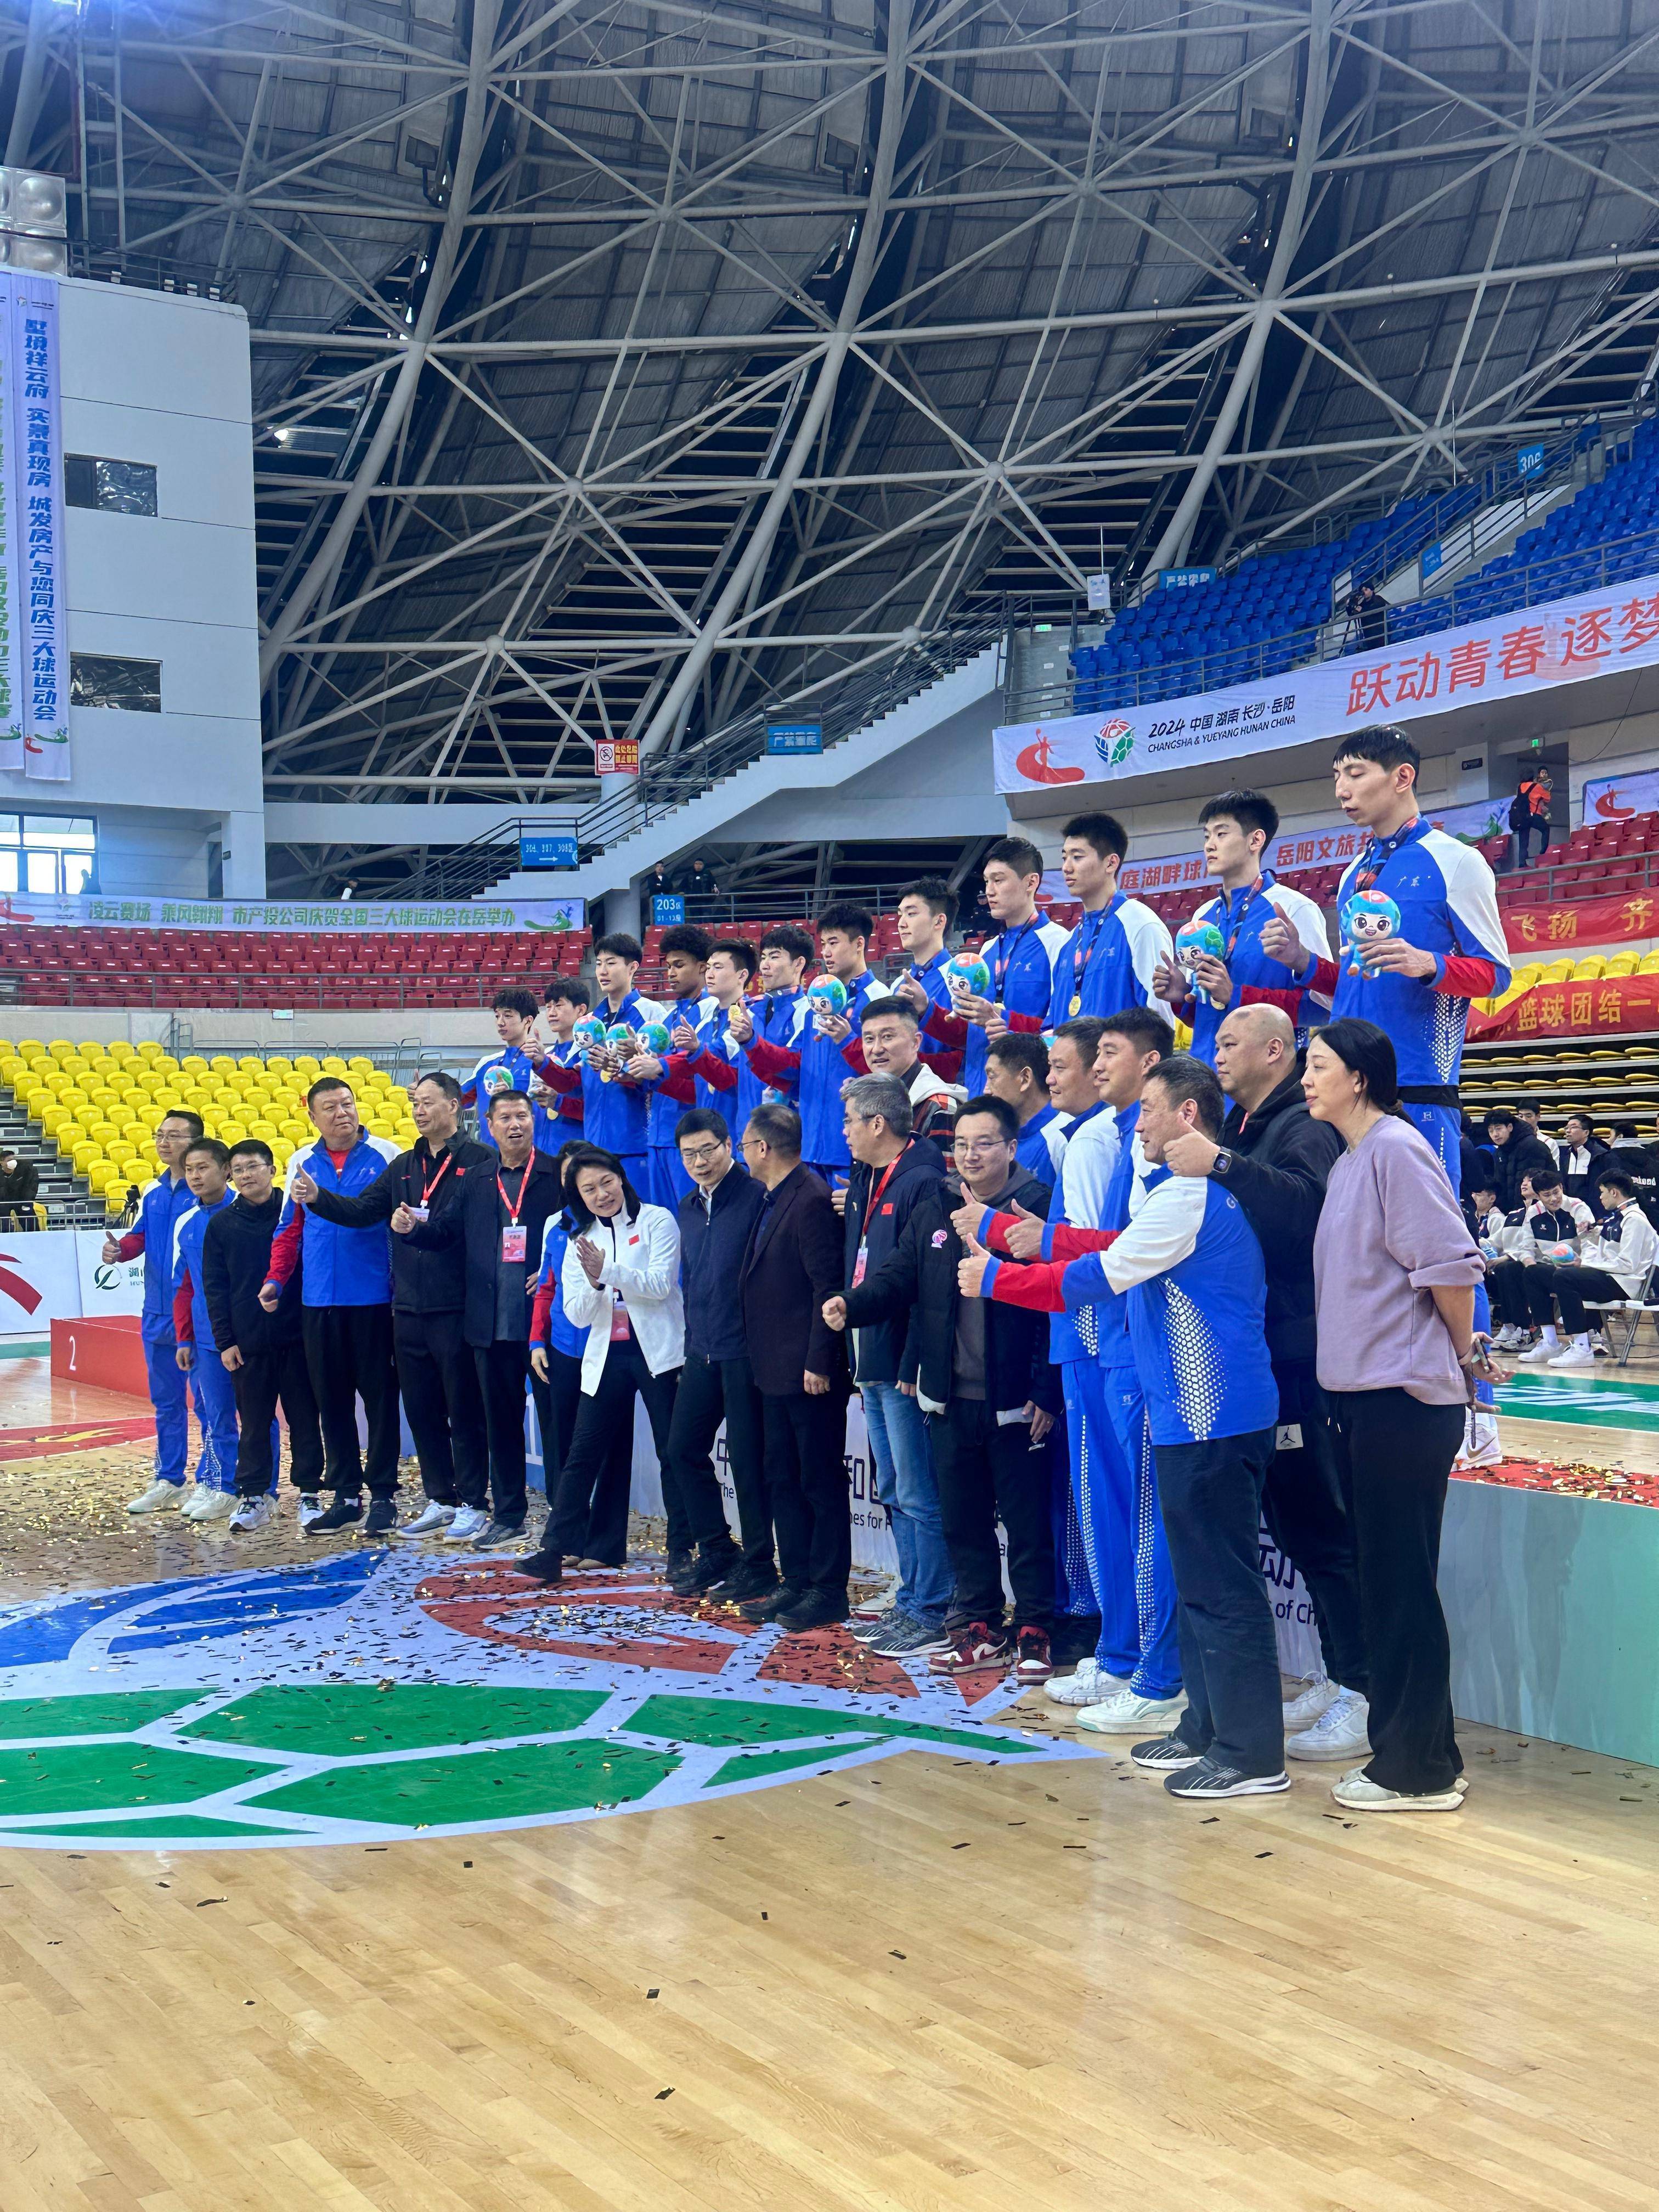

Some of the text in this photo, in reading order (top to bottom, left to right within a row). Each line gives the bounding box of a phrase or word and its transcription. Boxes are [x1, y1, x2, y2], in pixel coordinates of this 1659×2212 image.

[27, 495, 58, 721] 城发房产与您同庆三大球运动会
[1346, 592, 1659, 716] 跃动青春 逐梦
[1148, 718, 1186, 738] 2024
[1189, 713, 1214, 731] 中国
[1215, 708, 1240, 727] 湖南
[1148, 714, 1296, 753] CHANGSHA & YUEYANG HUNAN CHINA
[1119, 859, 1209, 890] 庭湖畔球
[89, 901, 151, 922] 凌云赛场
[233, 905, 516, 926] 市产投公司庆贺全国三大球运动会在岳举办
[657, 898, 681, 910] 203区
[1511, 909, 1580, 942] 飞扬
[1516, 988, 1659, 1032] 篮球团结一
[69, 1335, 76, 1371] 2
[721, 1482, 735, 1499] he
[867, 1511, 883, 1530] for
[1276, 1600, 1317, 1626] of Ch
